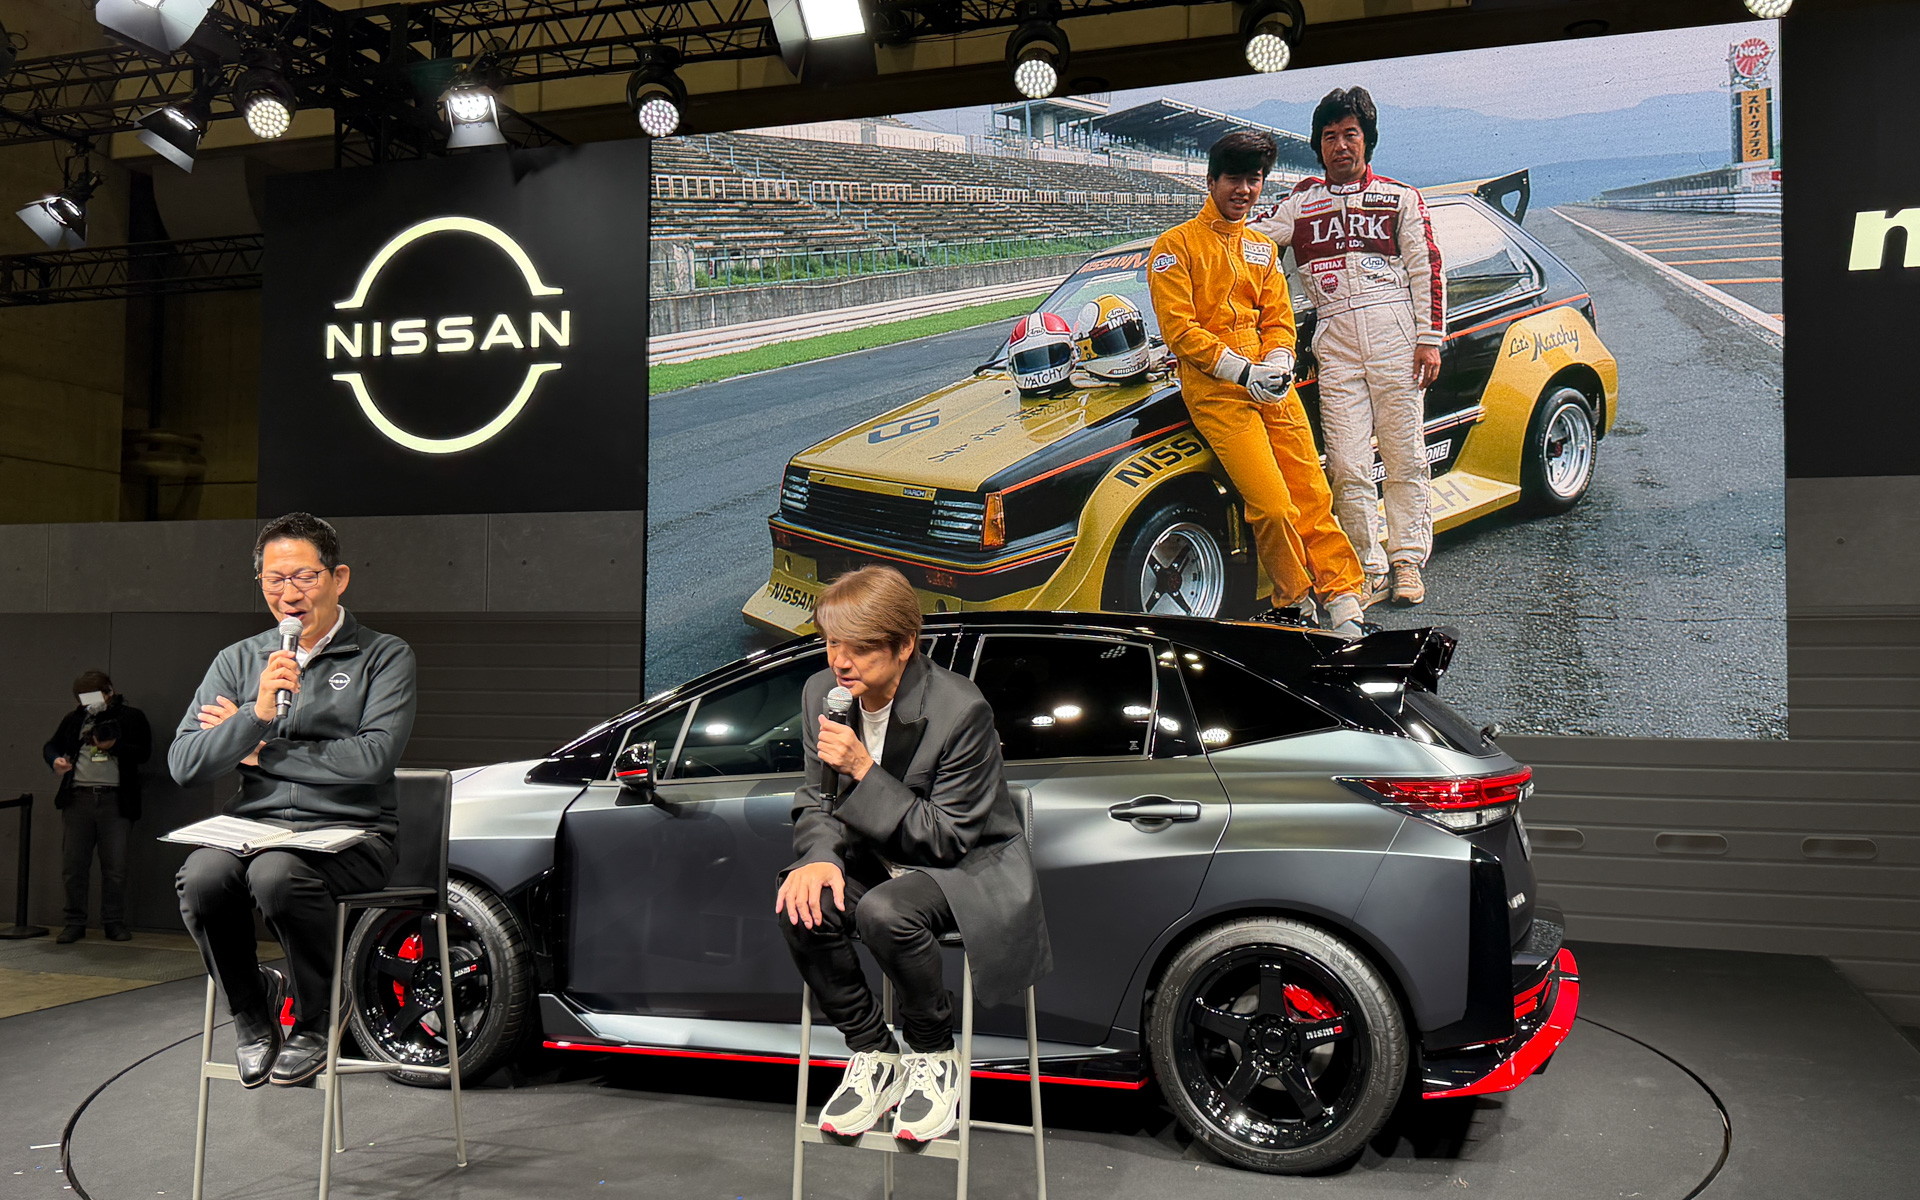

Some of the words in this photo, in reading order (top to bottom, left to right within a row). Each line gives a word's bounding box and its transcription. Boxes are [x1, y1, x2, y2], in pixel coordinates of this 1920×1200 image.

[1739, 45, 1765, 57] NGK
[1365, 193, 1398, 204] IMPUL
[1310, 213, 1390, 244] LARK
[1313, 260, 1343, 272] PENTAX
[325, 310, 571, 359] NISSAN
[1024, 367, 1064, 388] MATCHY
